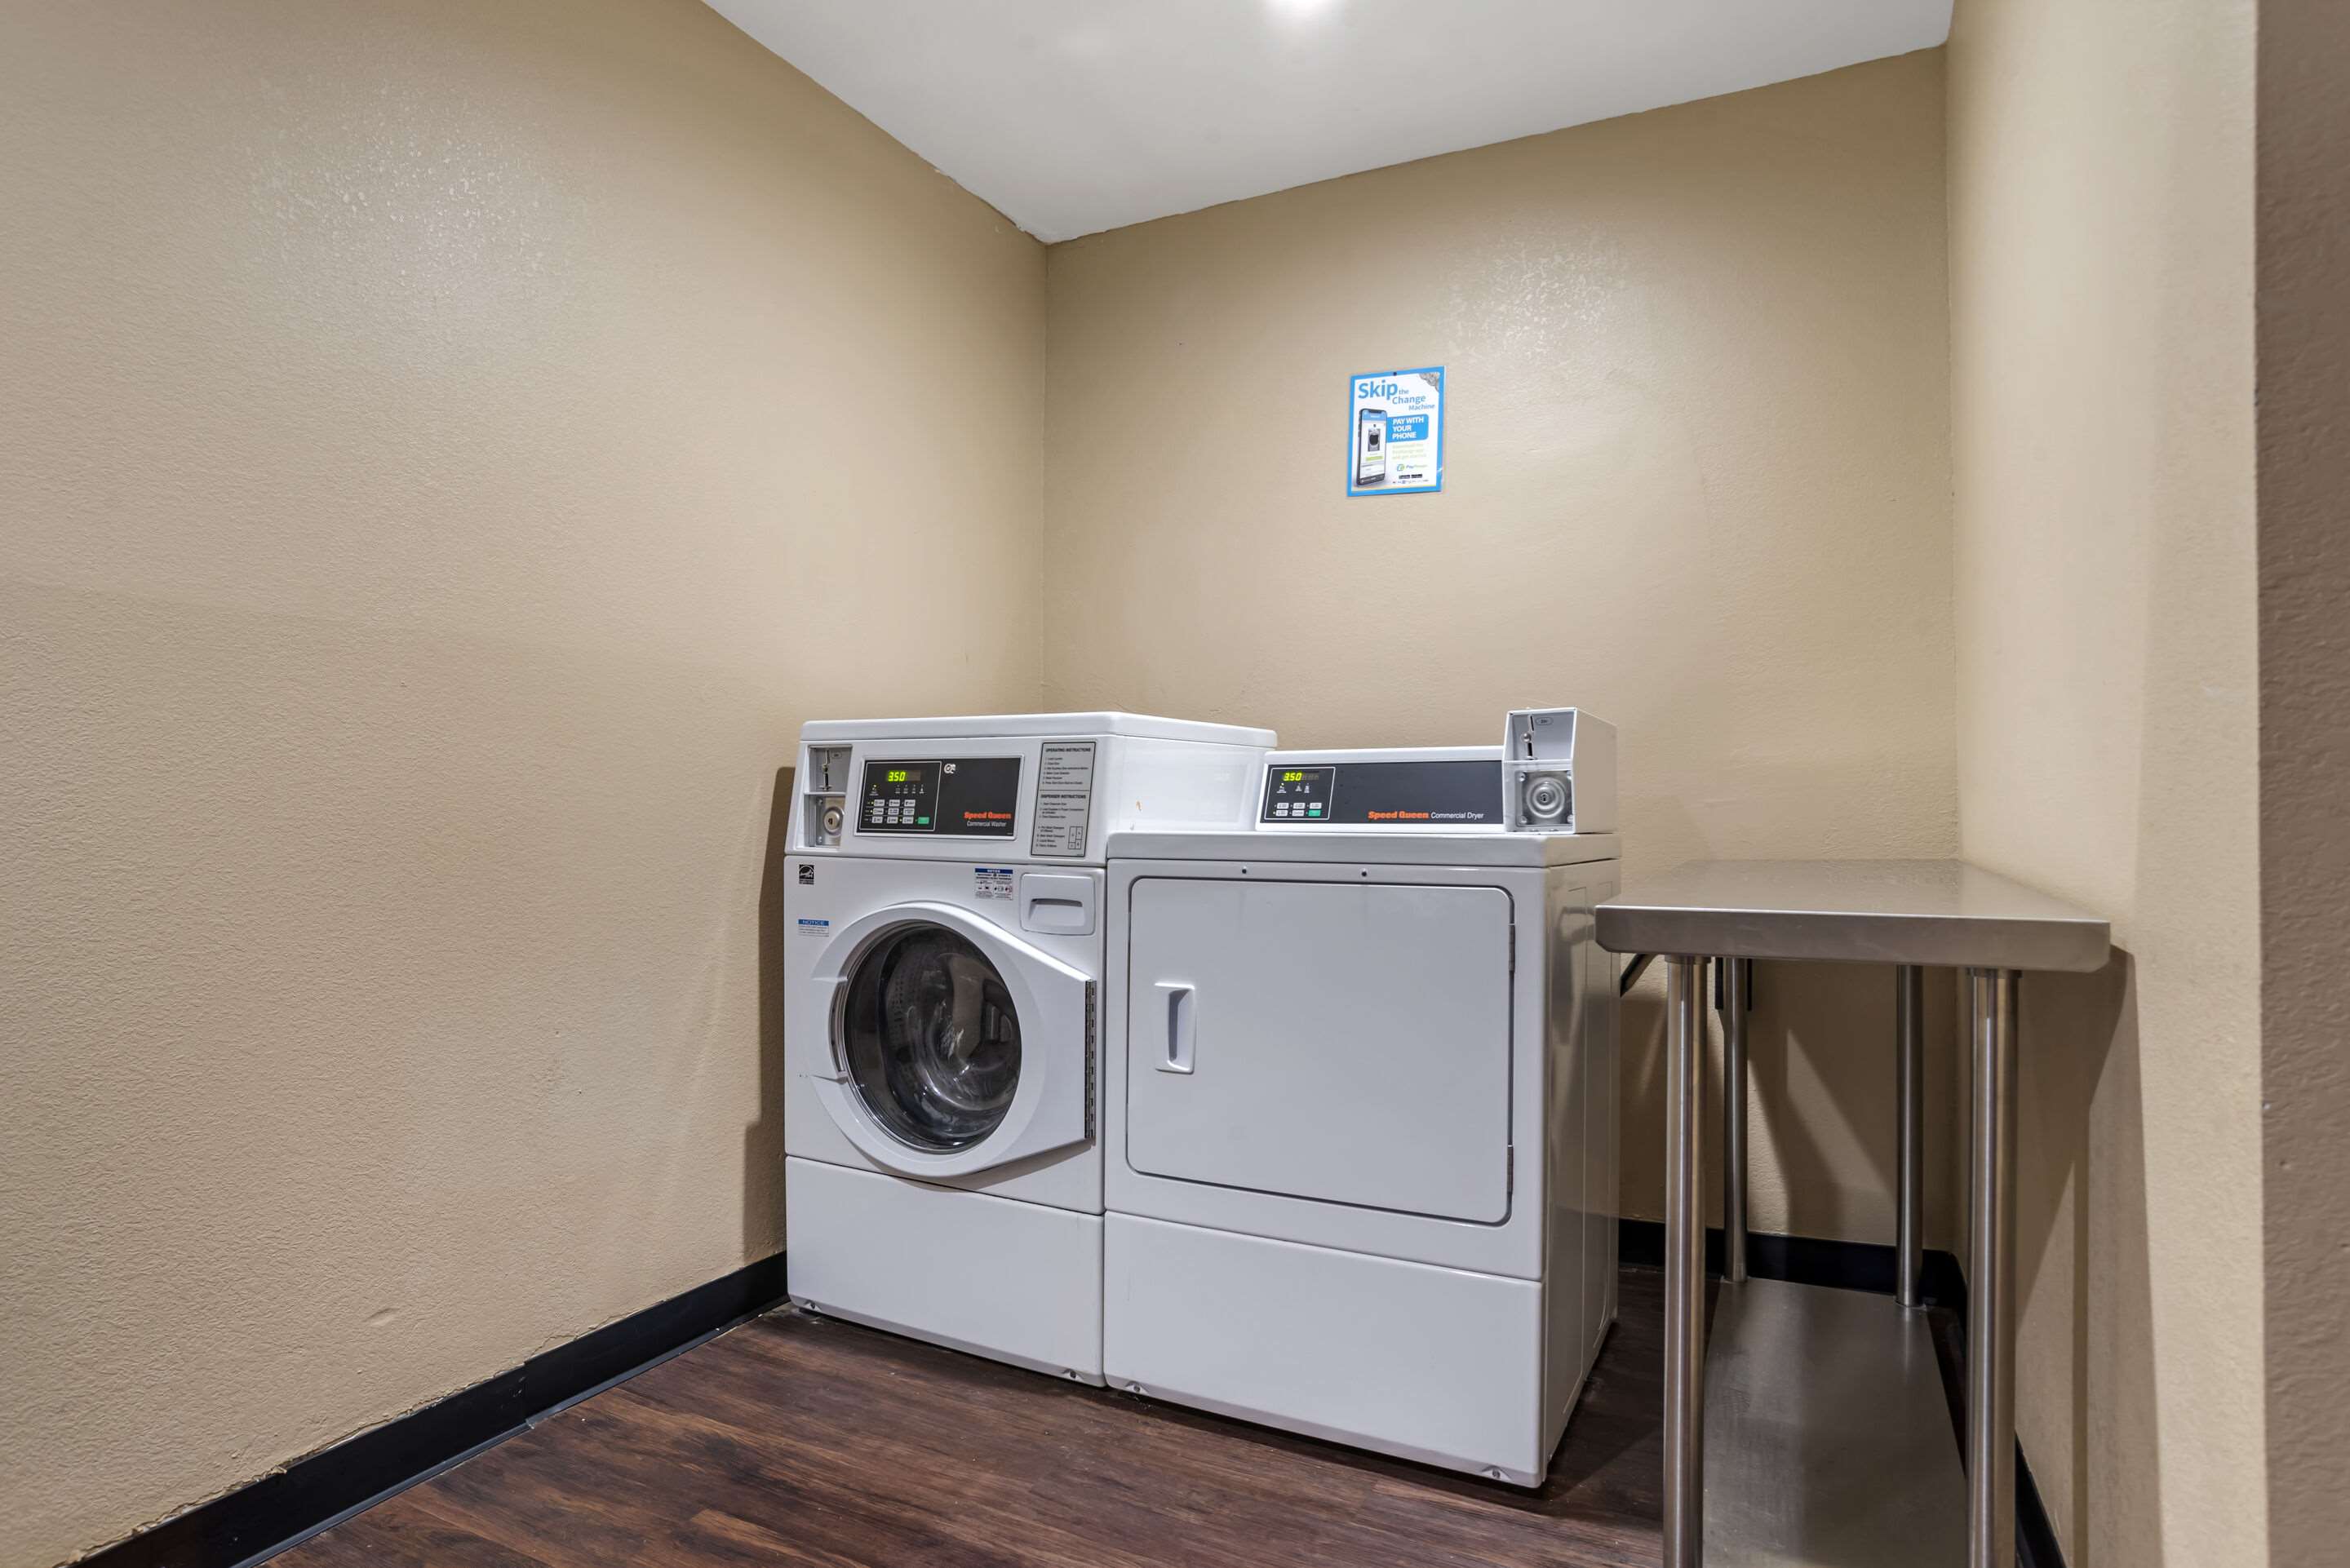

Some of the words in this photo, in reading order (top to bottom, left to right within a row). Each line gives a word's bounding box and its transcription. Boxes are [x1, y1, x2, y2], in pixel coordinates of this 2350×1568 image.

[1358, 379, 1398, 401] Skip
[1392, 395, 1426, 405] Change
[1392, 432, 1417, 440] PHONE
[964, 811, 987, 819] Speed
[987, 811, 1012, 819] Queen
[1368, 811, 1398, 820] Speed
[1399, 811, 1430, 819] Queen
[1466, 812, 1484, 820] Dryer
